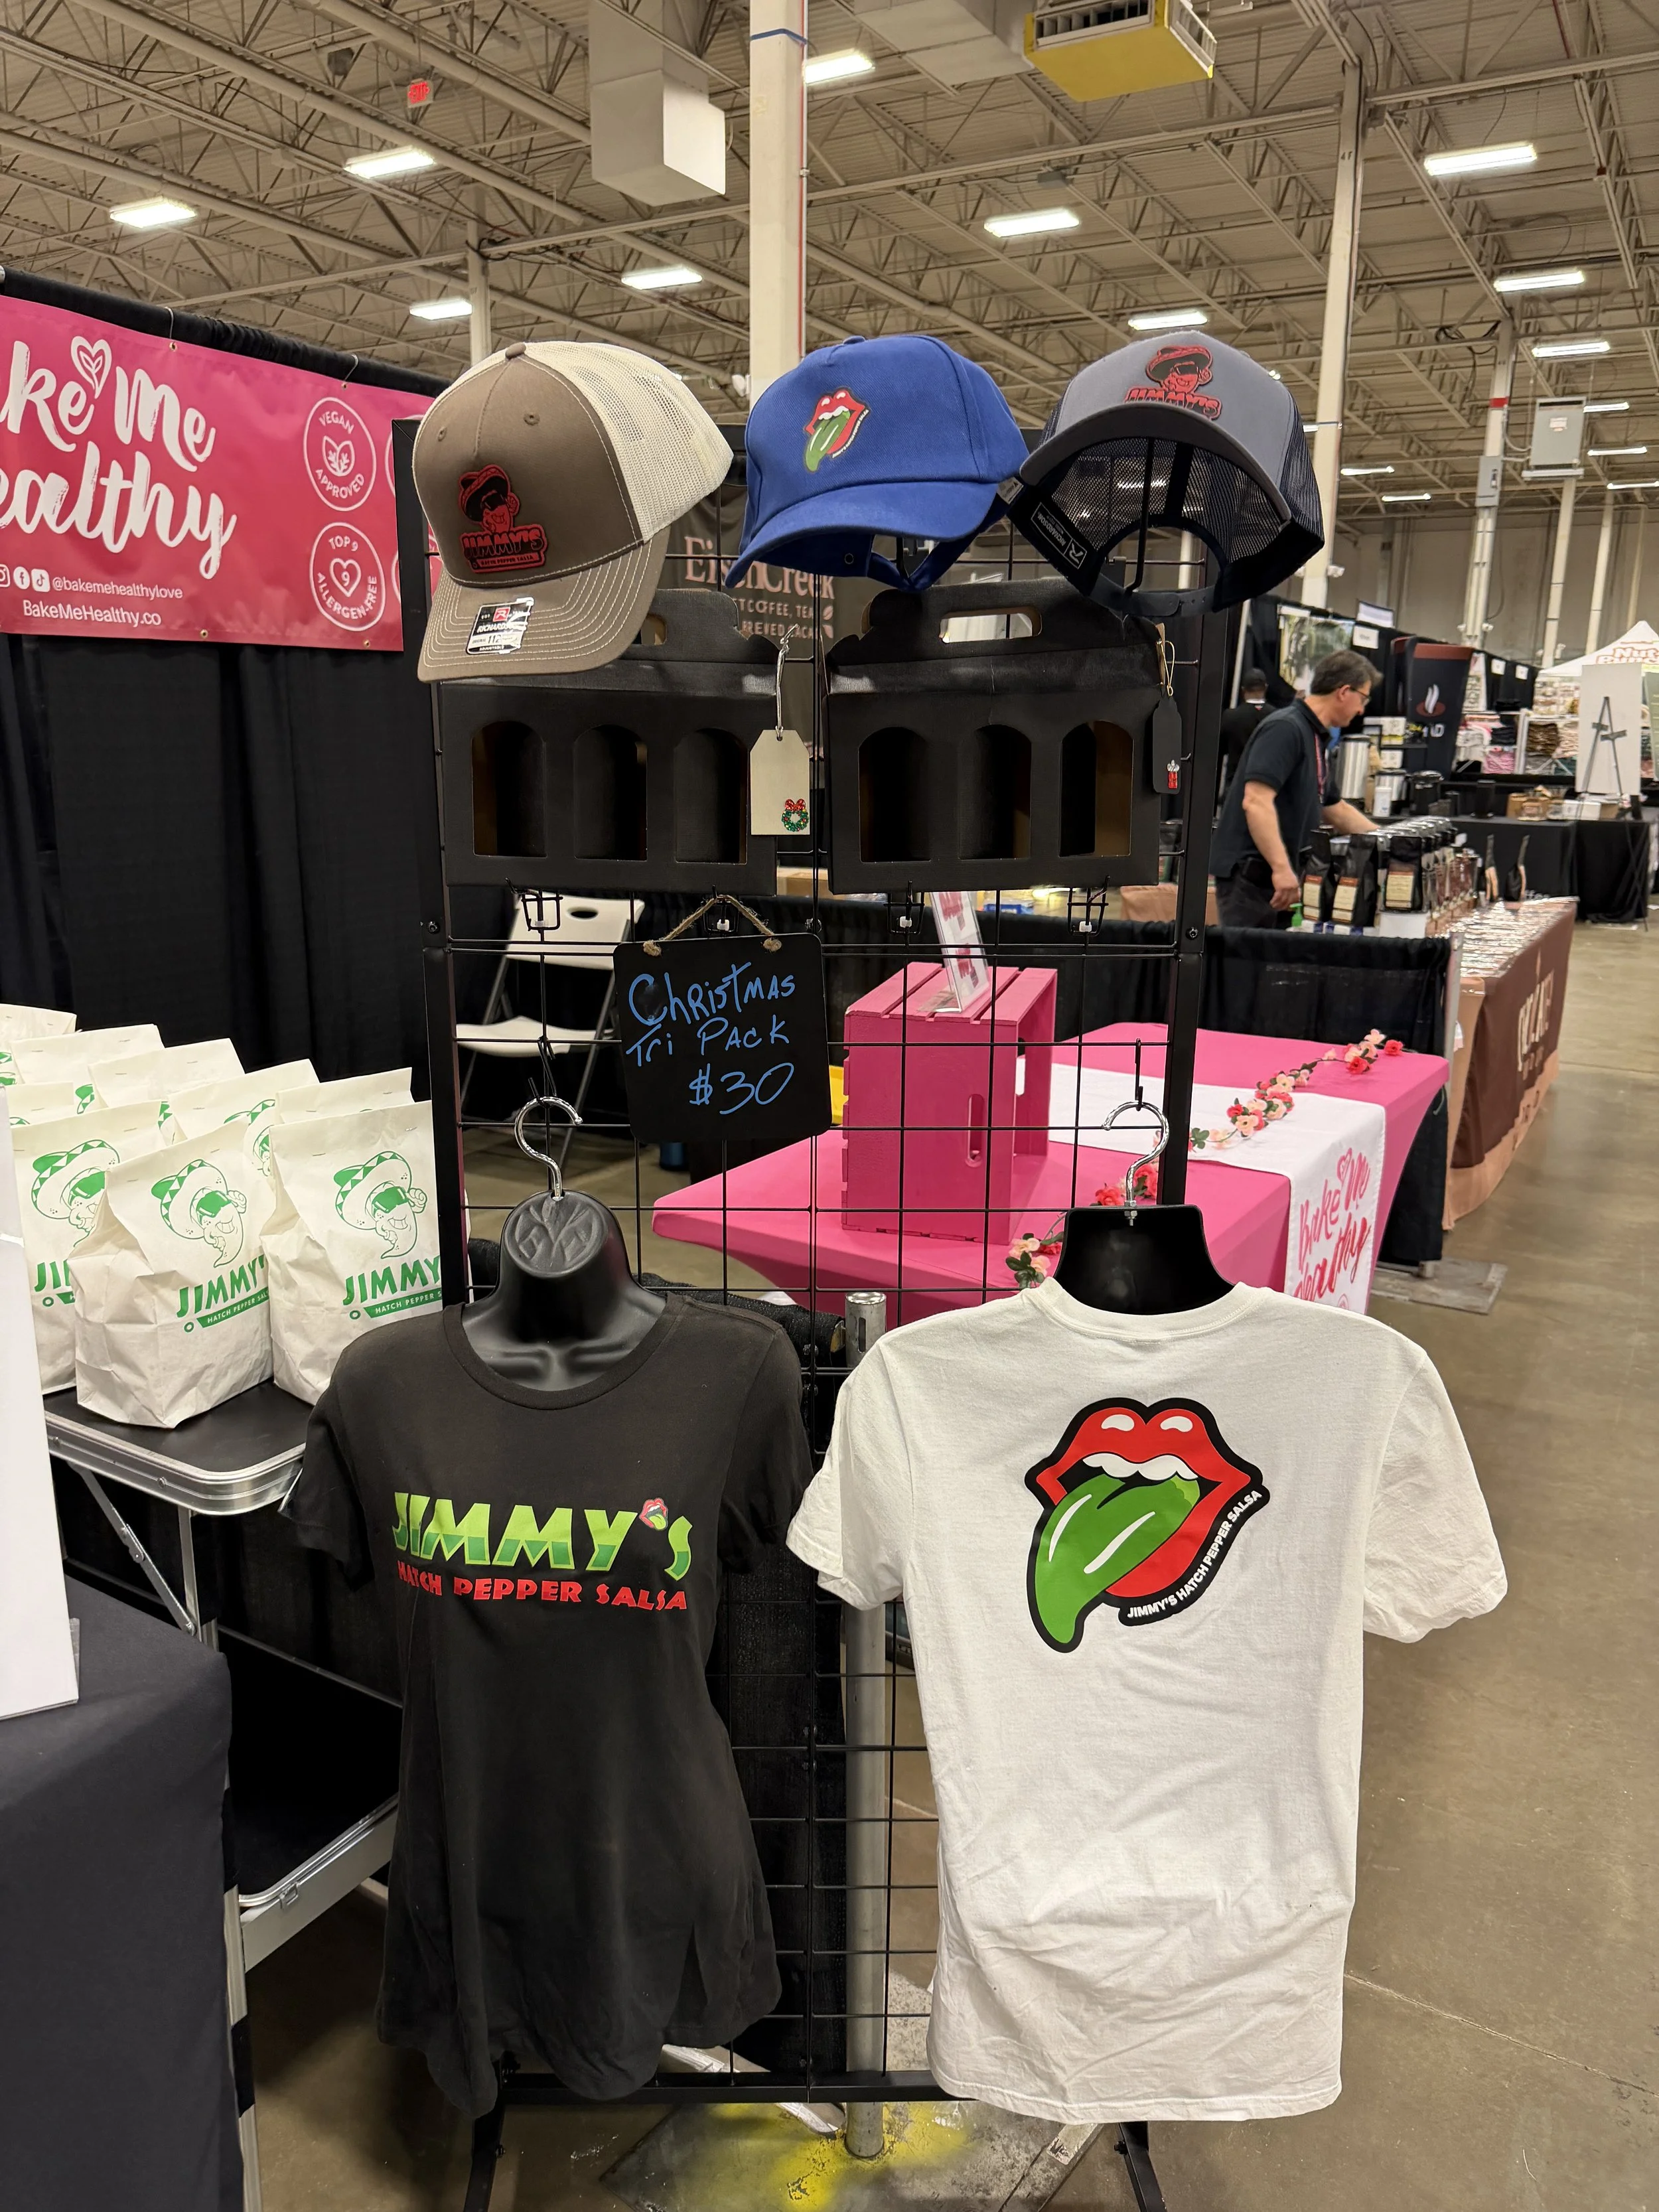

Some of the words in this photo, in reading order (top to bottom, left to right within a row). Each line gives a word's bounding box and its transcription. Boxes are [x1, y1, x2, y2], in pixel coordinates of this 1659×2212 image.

[0, 341, 94, 452] ke
[319, 411, 354, 435] VEGAN
[315, 469, 365, 499] APPROVED
[328, 536, 350, 550] TOP
[351, 544, 358, 552] 9
[1031, 512, 1066, 547] RICHARDSON
[52, 577, 183, 600] @bakemehealthylove
[340, 571, 351, 587] 9
[318, 575, 378, 620] ALLERGEN-FREE
[747, 599, 793, 619] COFFEE,
[23, 599, 161, 628] BakeMeHealthy.co
[488, 634, 502, 644] 112
[689, 1063, 795, 1115] $30
[177, 1254, 265, 1318] JIMMY'
[342, 1254, 441, 1306] JIMMY
[207, 1309, 231, 1324] HATCH
[234, 1297, 255, 1313] PEPPER
[375, 1301, 402, 1314] HATCH
[405, 1293, 434, 1305] PEPPER
[1127, 1594, 1178, 1618] JIMMY'S
[1175, 1564, 1209, 1601] HATCH
[1202, 1520, 1232, 1566] PEPPER
[1227, 1490, 1262, 1522] SALSA
[397, 1560, 443, 1595] HATCH
[453, 1578, 582, 1603] PEPPER
[595, 1584, 687, 1611] SALSA
